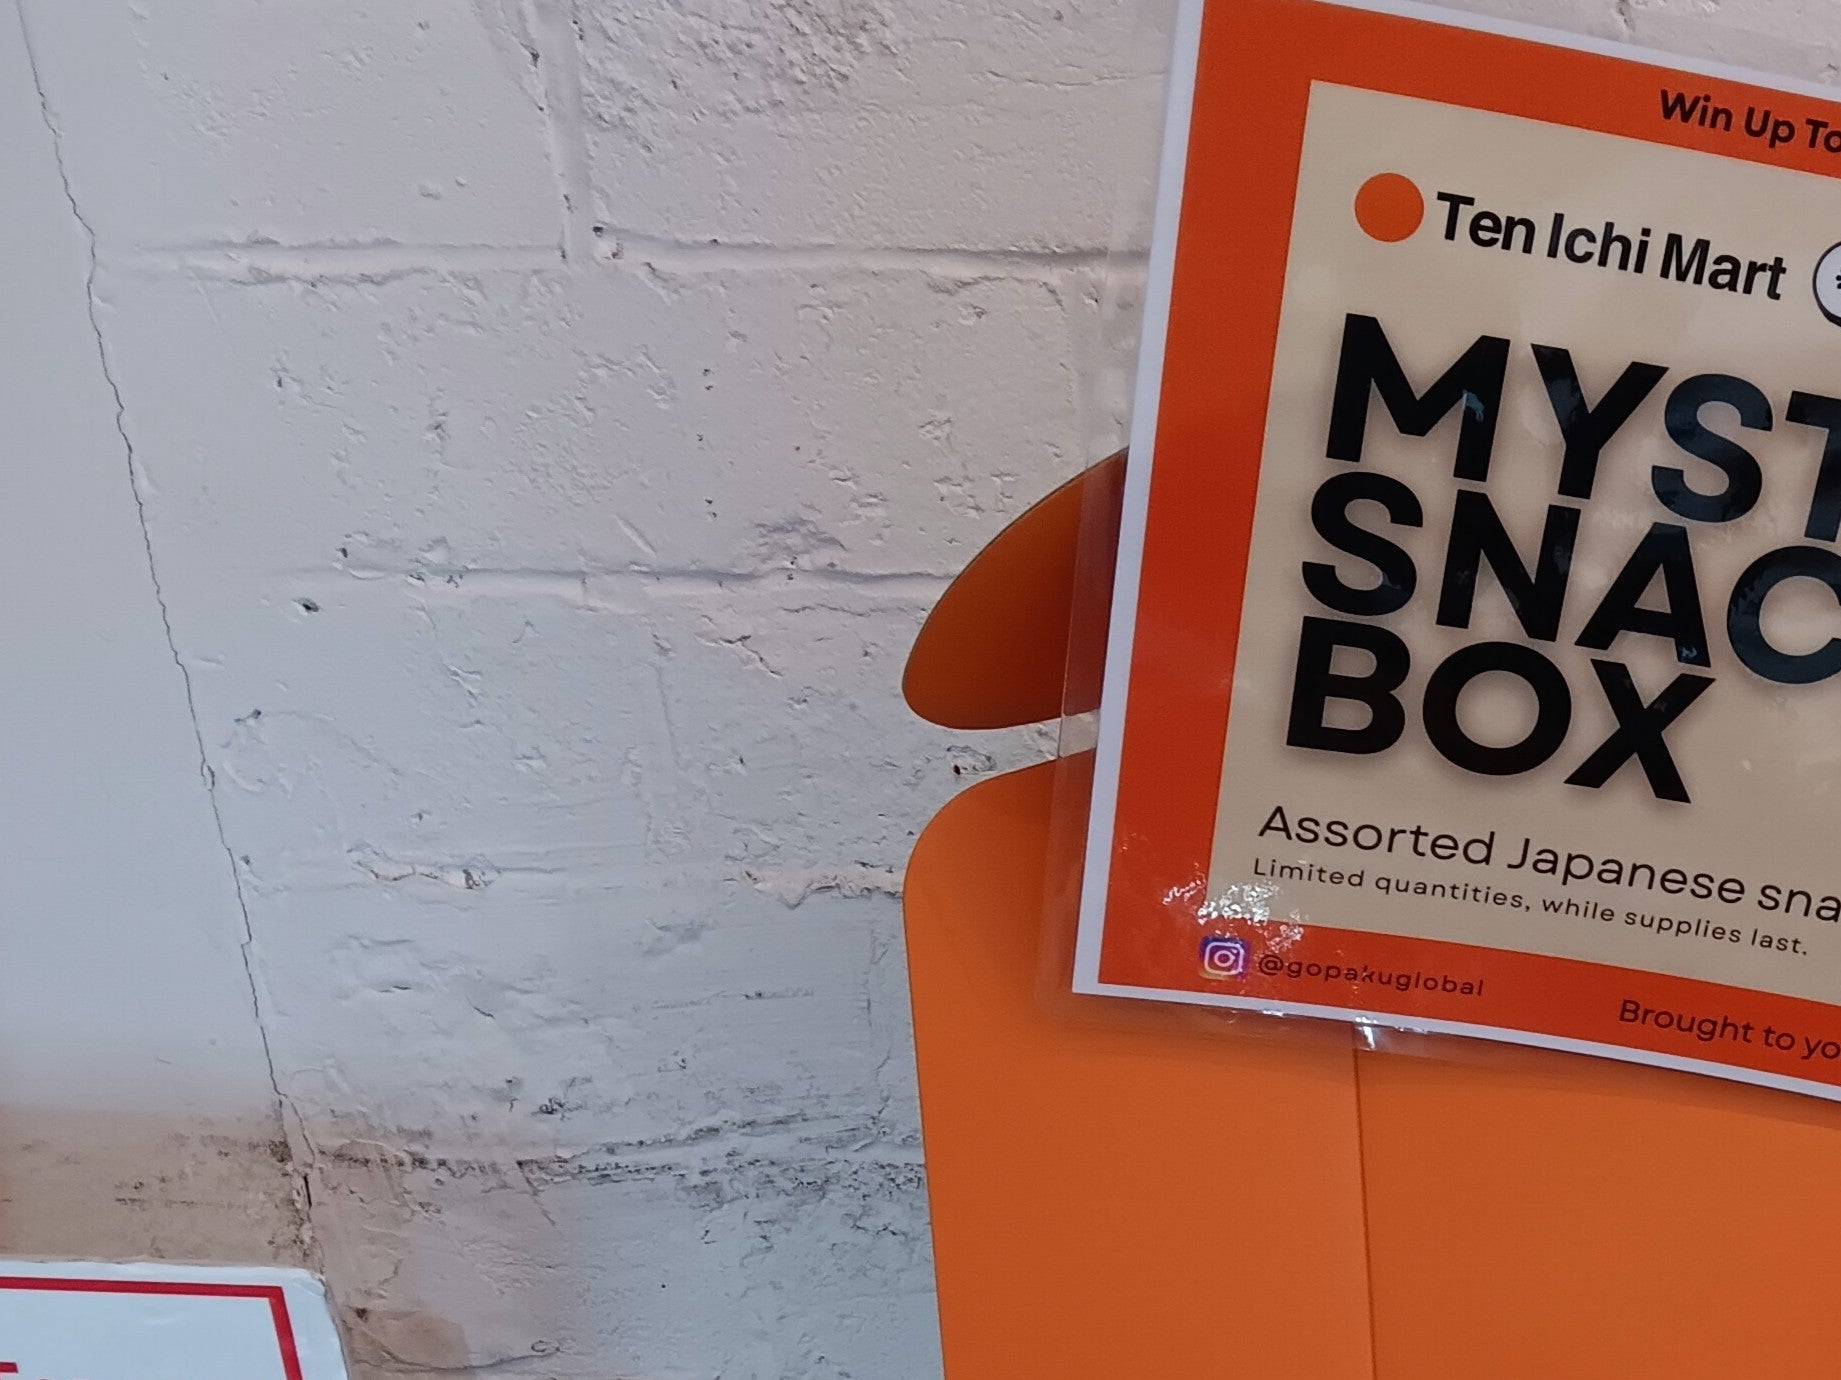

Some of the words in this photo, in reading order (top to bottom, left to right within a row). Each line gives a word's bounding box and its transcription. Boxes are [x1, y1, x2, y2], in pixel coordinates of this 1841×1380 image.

[1660, 89, 1733, 132] Win
[1744, 107, 1796, 151] Up
[1436, 191, 1536, 253] Ten
[1547, 212, 1651, 274] Ichi
[1659, 233, 1786, 300] Mart
[1286, 614, 1716, 804] BOX
[1258, 804, 1498, 868] Assorted
[1506, 836, 1748, 907] Japanese
[1252, 857, 1366, 889] Limited
[1374, 873, 1533, 913] quantities,
[1541, 894, 1616, 924] while
[1624, 909, 1744, 945] supplies
[1750, 927, 1809, 957] last.
[1258, 952, 1486, 998] @gopakuglobal
[1618, 999, 1755, 1047] Brought
[1762, 1021, 1797, 1051] to
